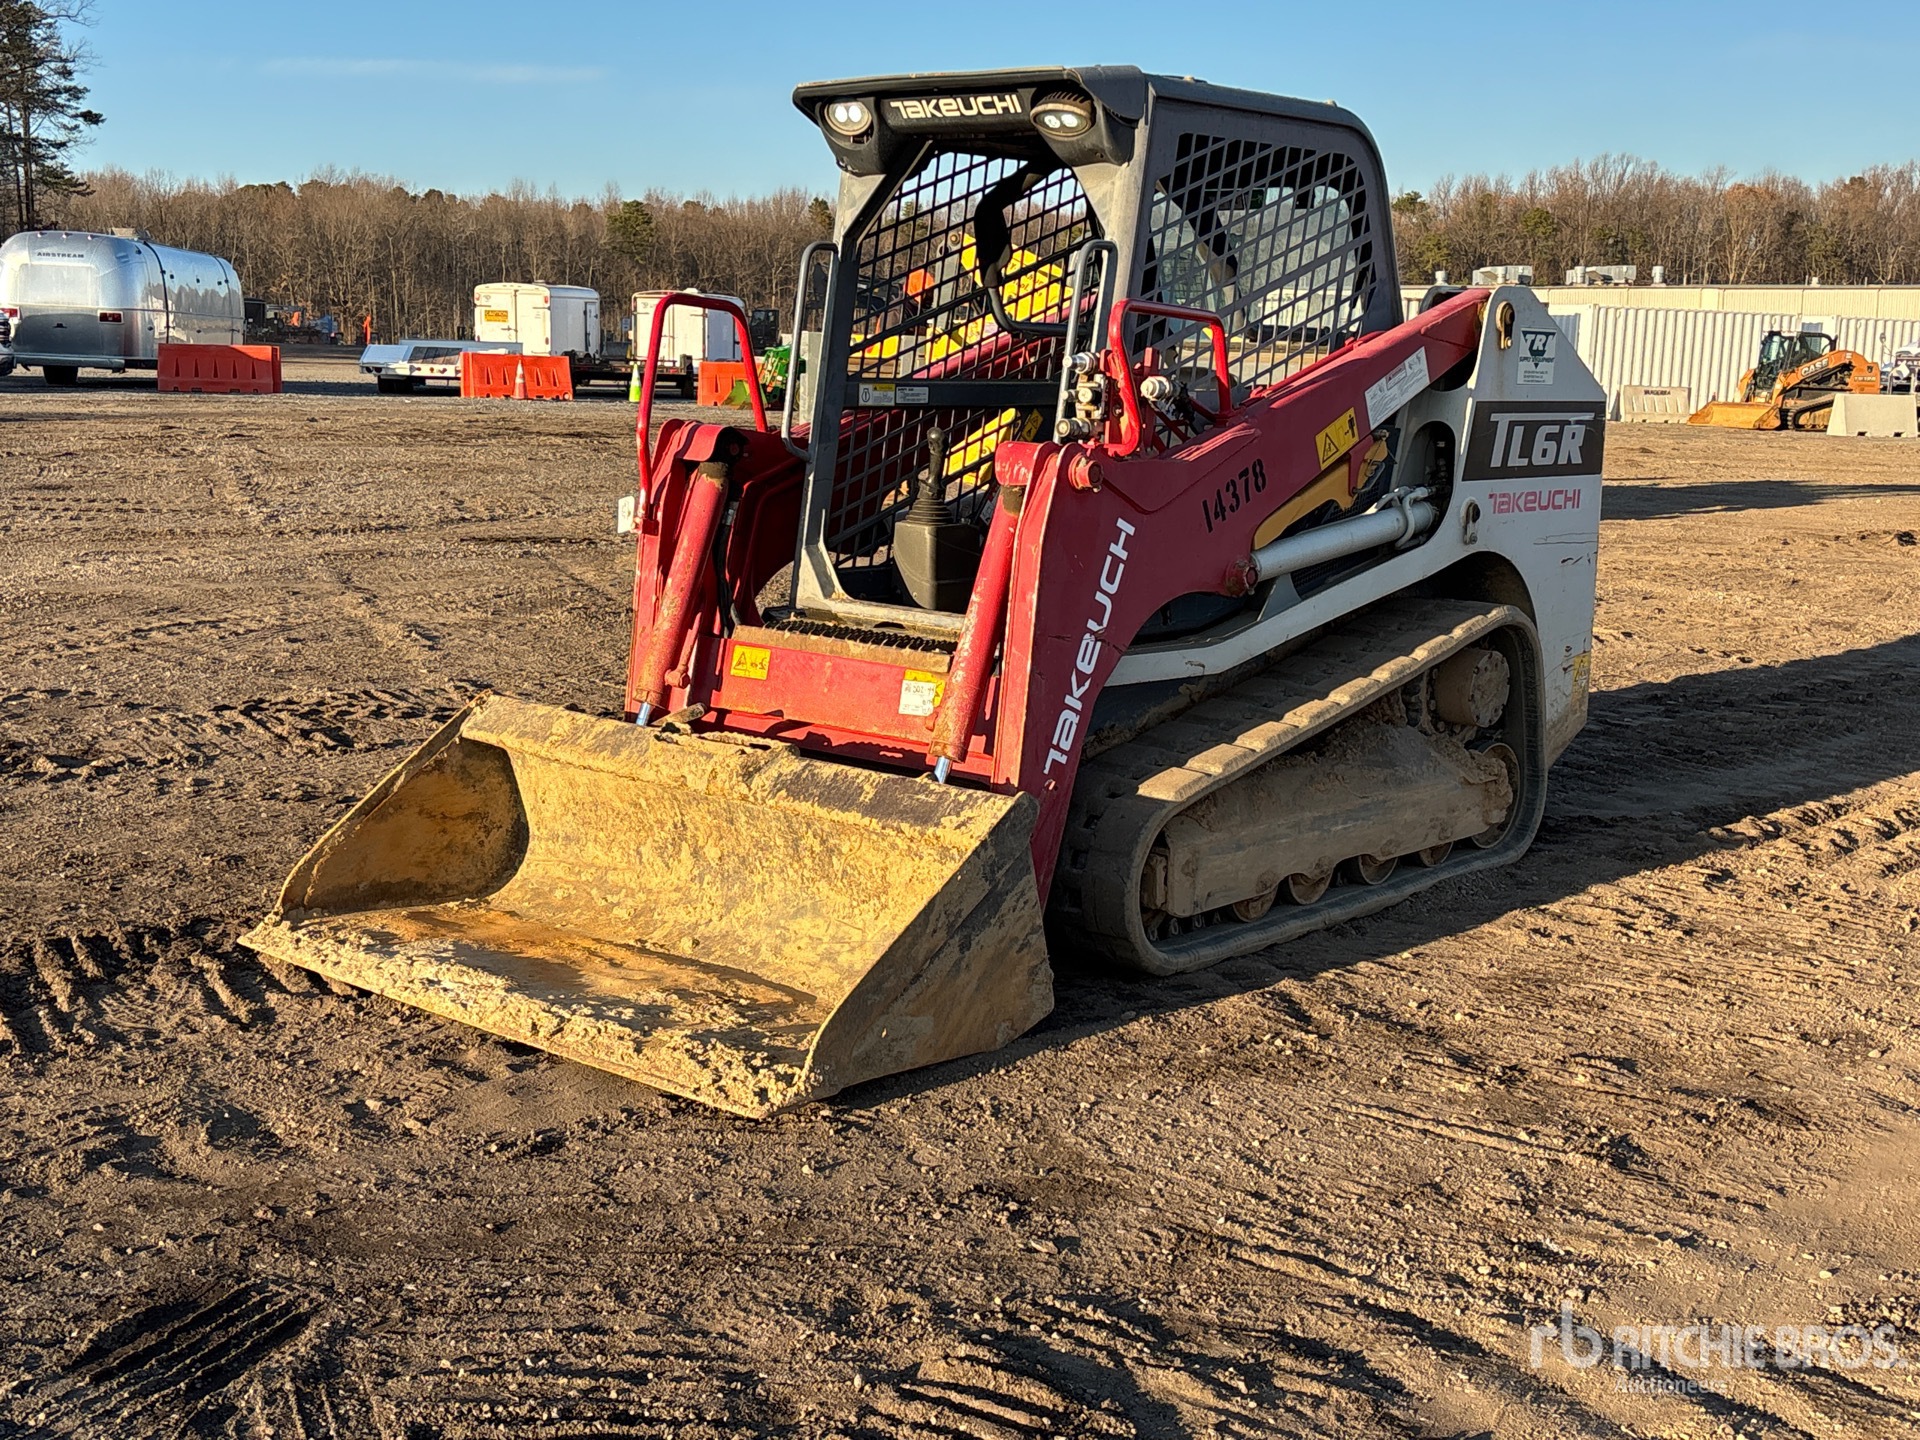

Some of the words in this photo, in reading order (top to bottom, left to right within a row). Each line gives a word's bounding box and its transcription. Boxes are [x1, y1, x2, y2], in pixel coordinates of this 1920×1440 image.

[890, 94, 1022, 119] TAKEUCHI
[1801, 360, 1828, 375] CASE
[1490, 413, 1595, 467] TL6R
[1202, 459, 1266, 533] 14378
[1488, 489, 1581, 514] TAKEUCHI
[1043, 517, 1136, 775] TAKEUCHI
